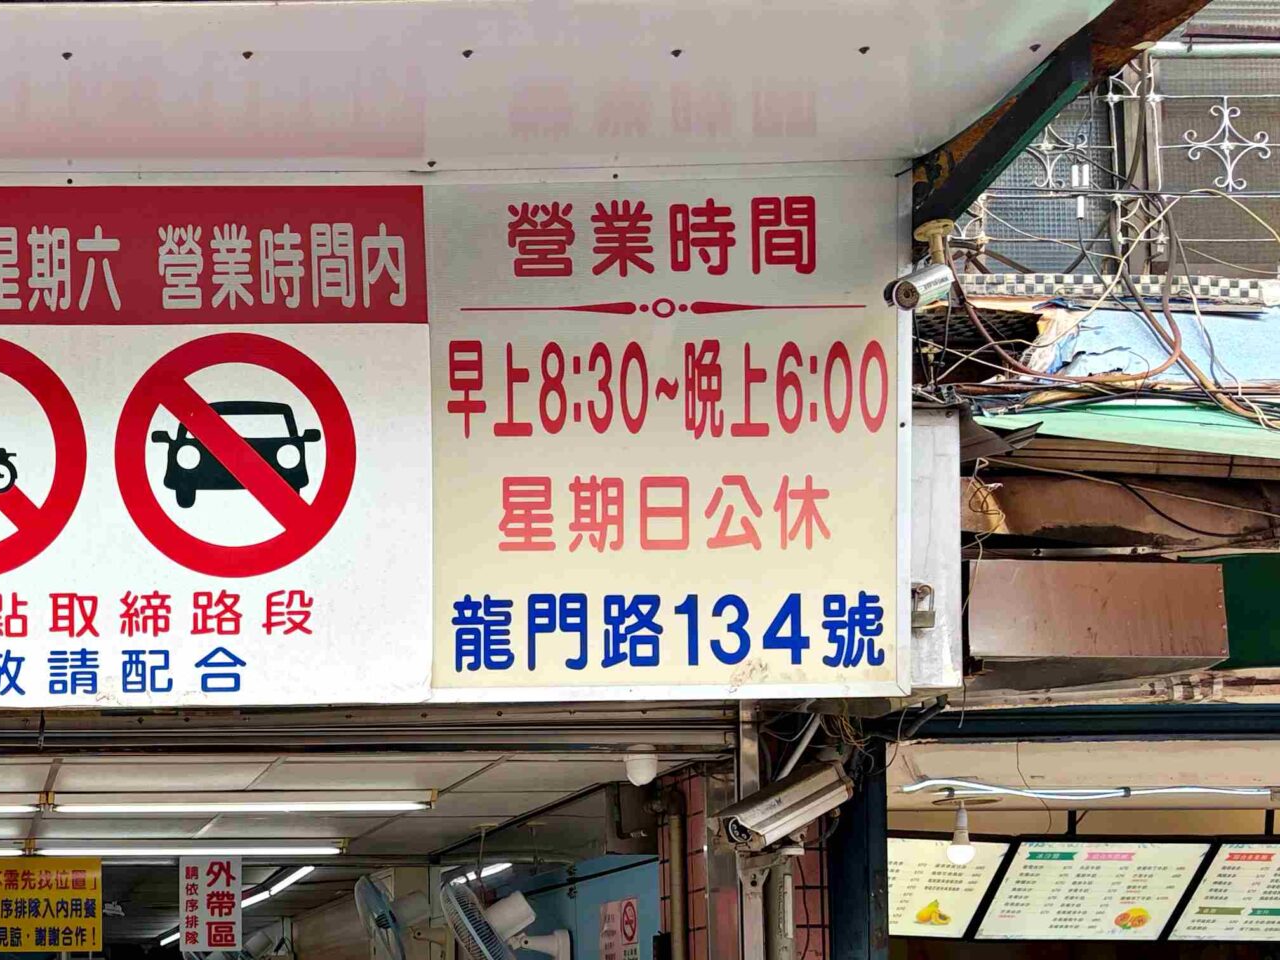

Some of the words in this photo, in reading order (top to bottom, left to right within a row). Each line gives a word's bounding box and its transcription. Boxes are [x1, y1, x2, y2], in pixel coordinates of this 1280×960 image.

[157, 222, 406, 310] 營業時間內
[507, 196, 816, 277] 營業時間
[498, 474, 831, 553] 星期日公休
[451, 591, 885, 672] 龍門路134號
[185, 866, 199, 945] 請依序排隊
[205, 861, 236, 947] 外帶區
